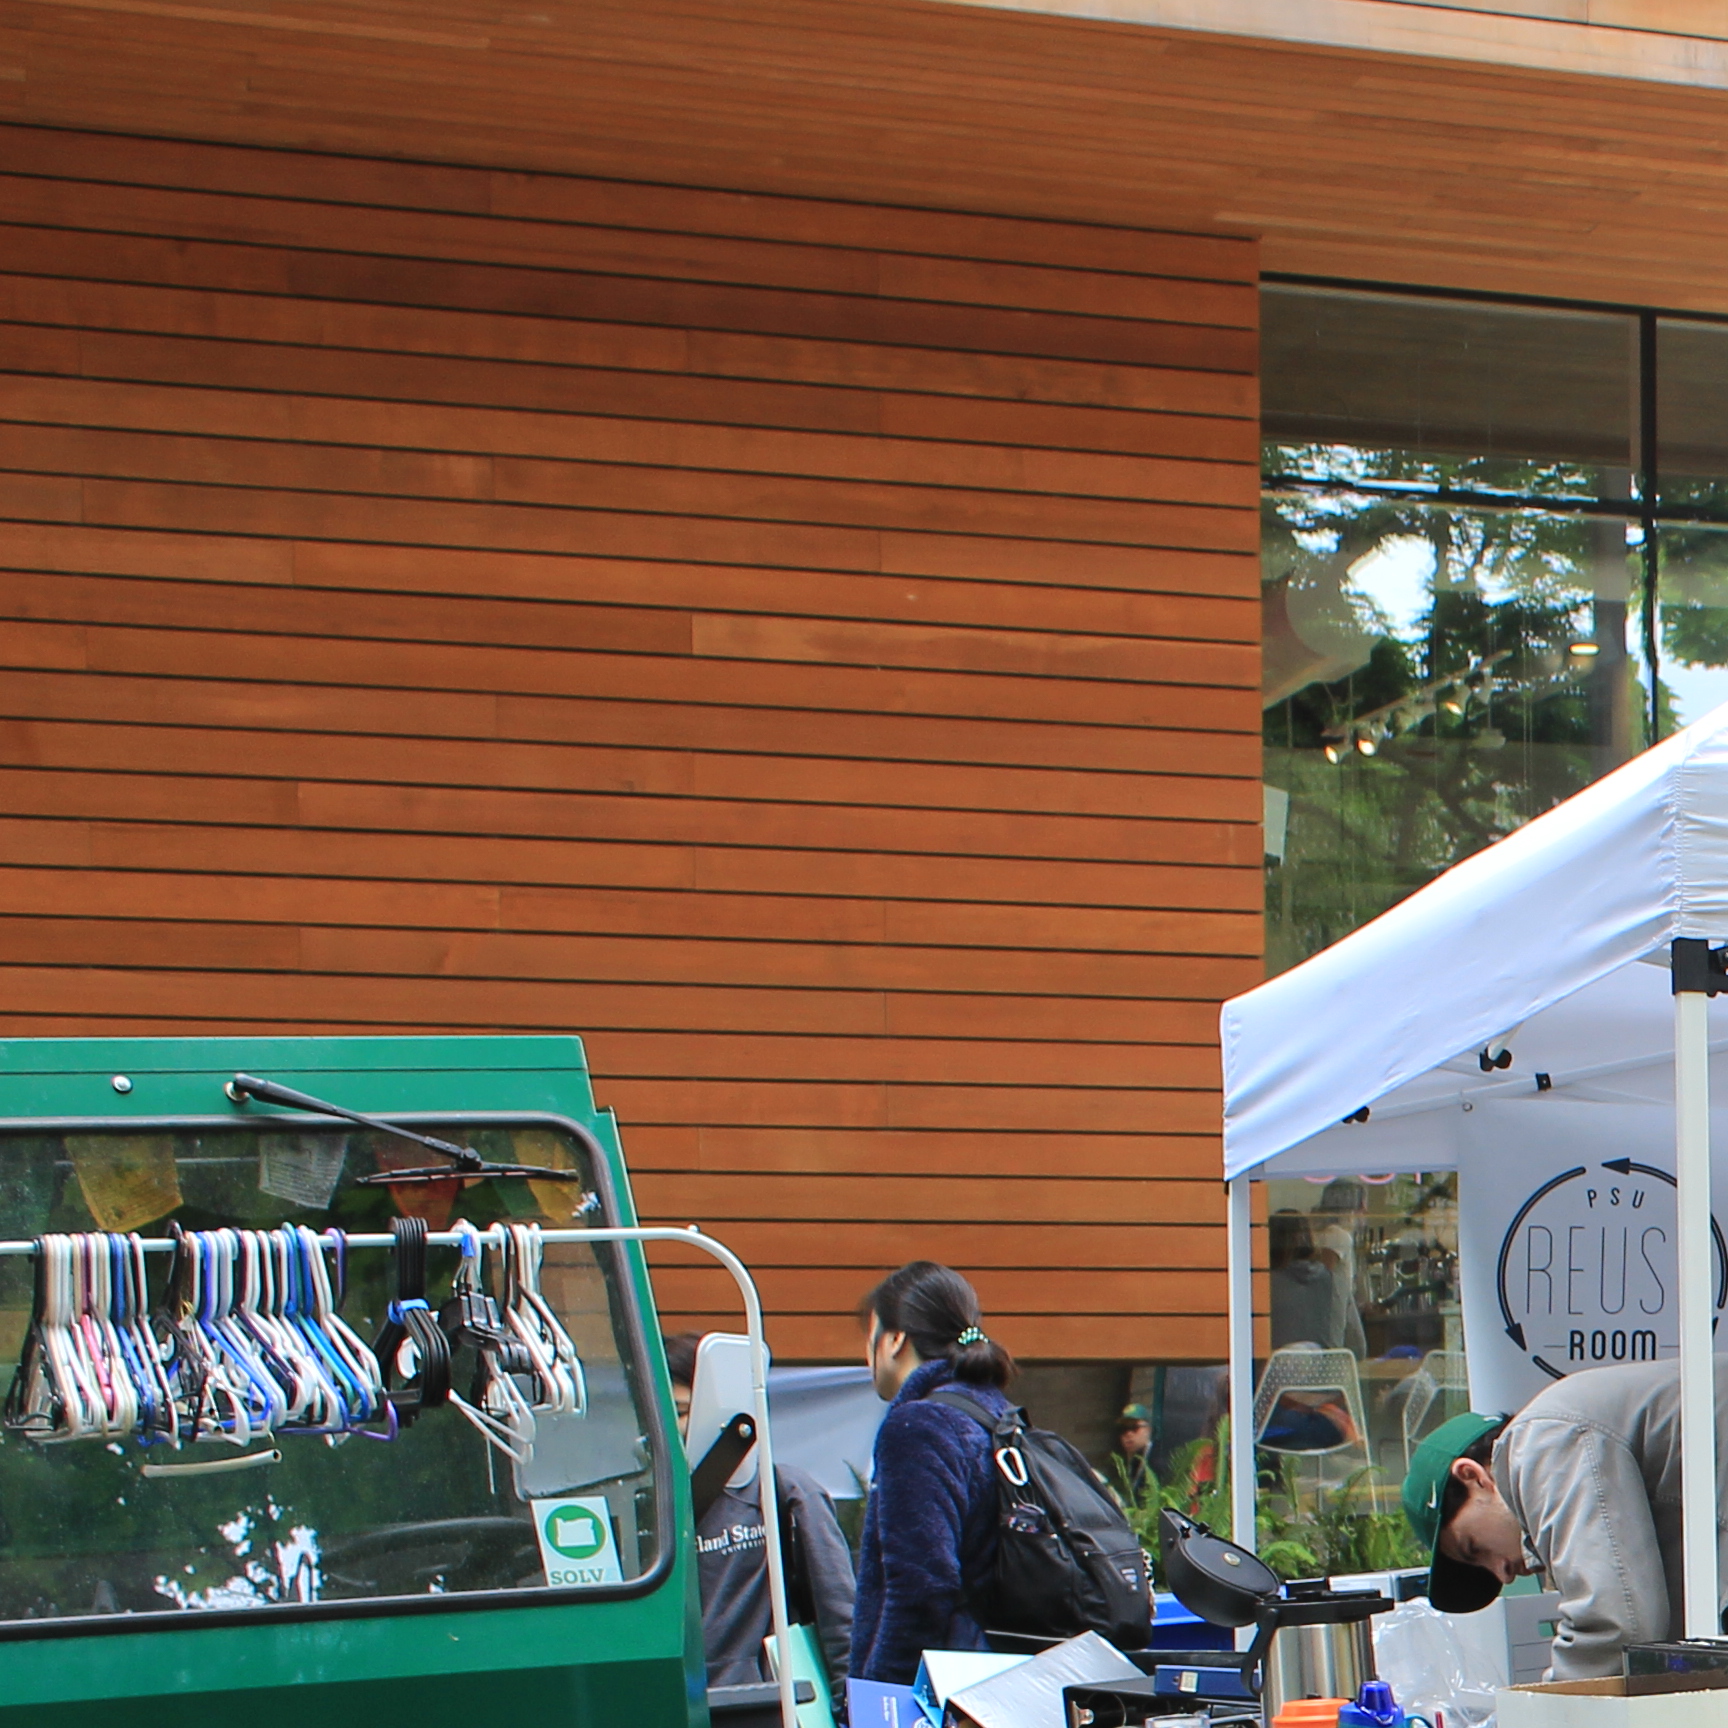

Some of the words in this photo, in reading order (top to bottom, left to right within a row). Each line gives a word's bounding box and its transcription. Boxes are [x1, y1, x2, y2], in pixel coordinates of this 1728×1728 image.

[1587, 1187, 1645, 1209] PSU
[1526, 1225, 1667, 1315] REUS
[1568, 1328, 1658, 1361] ROOM
[696, 1534, 729, 1553] land
